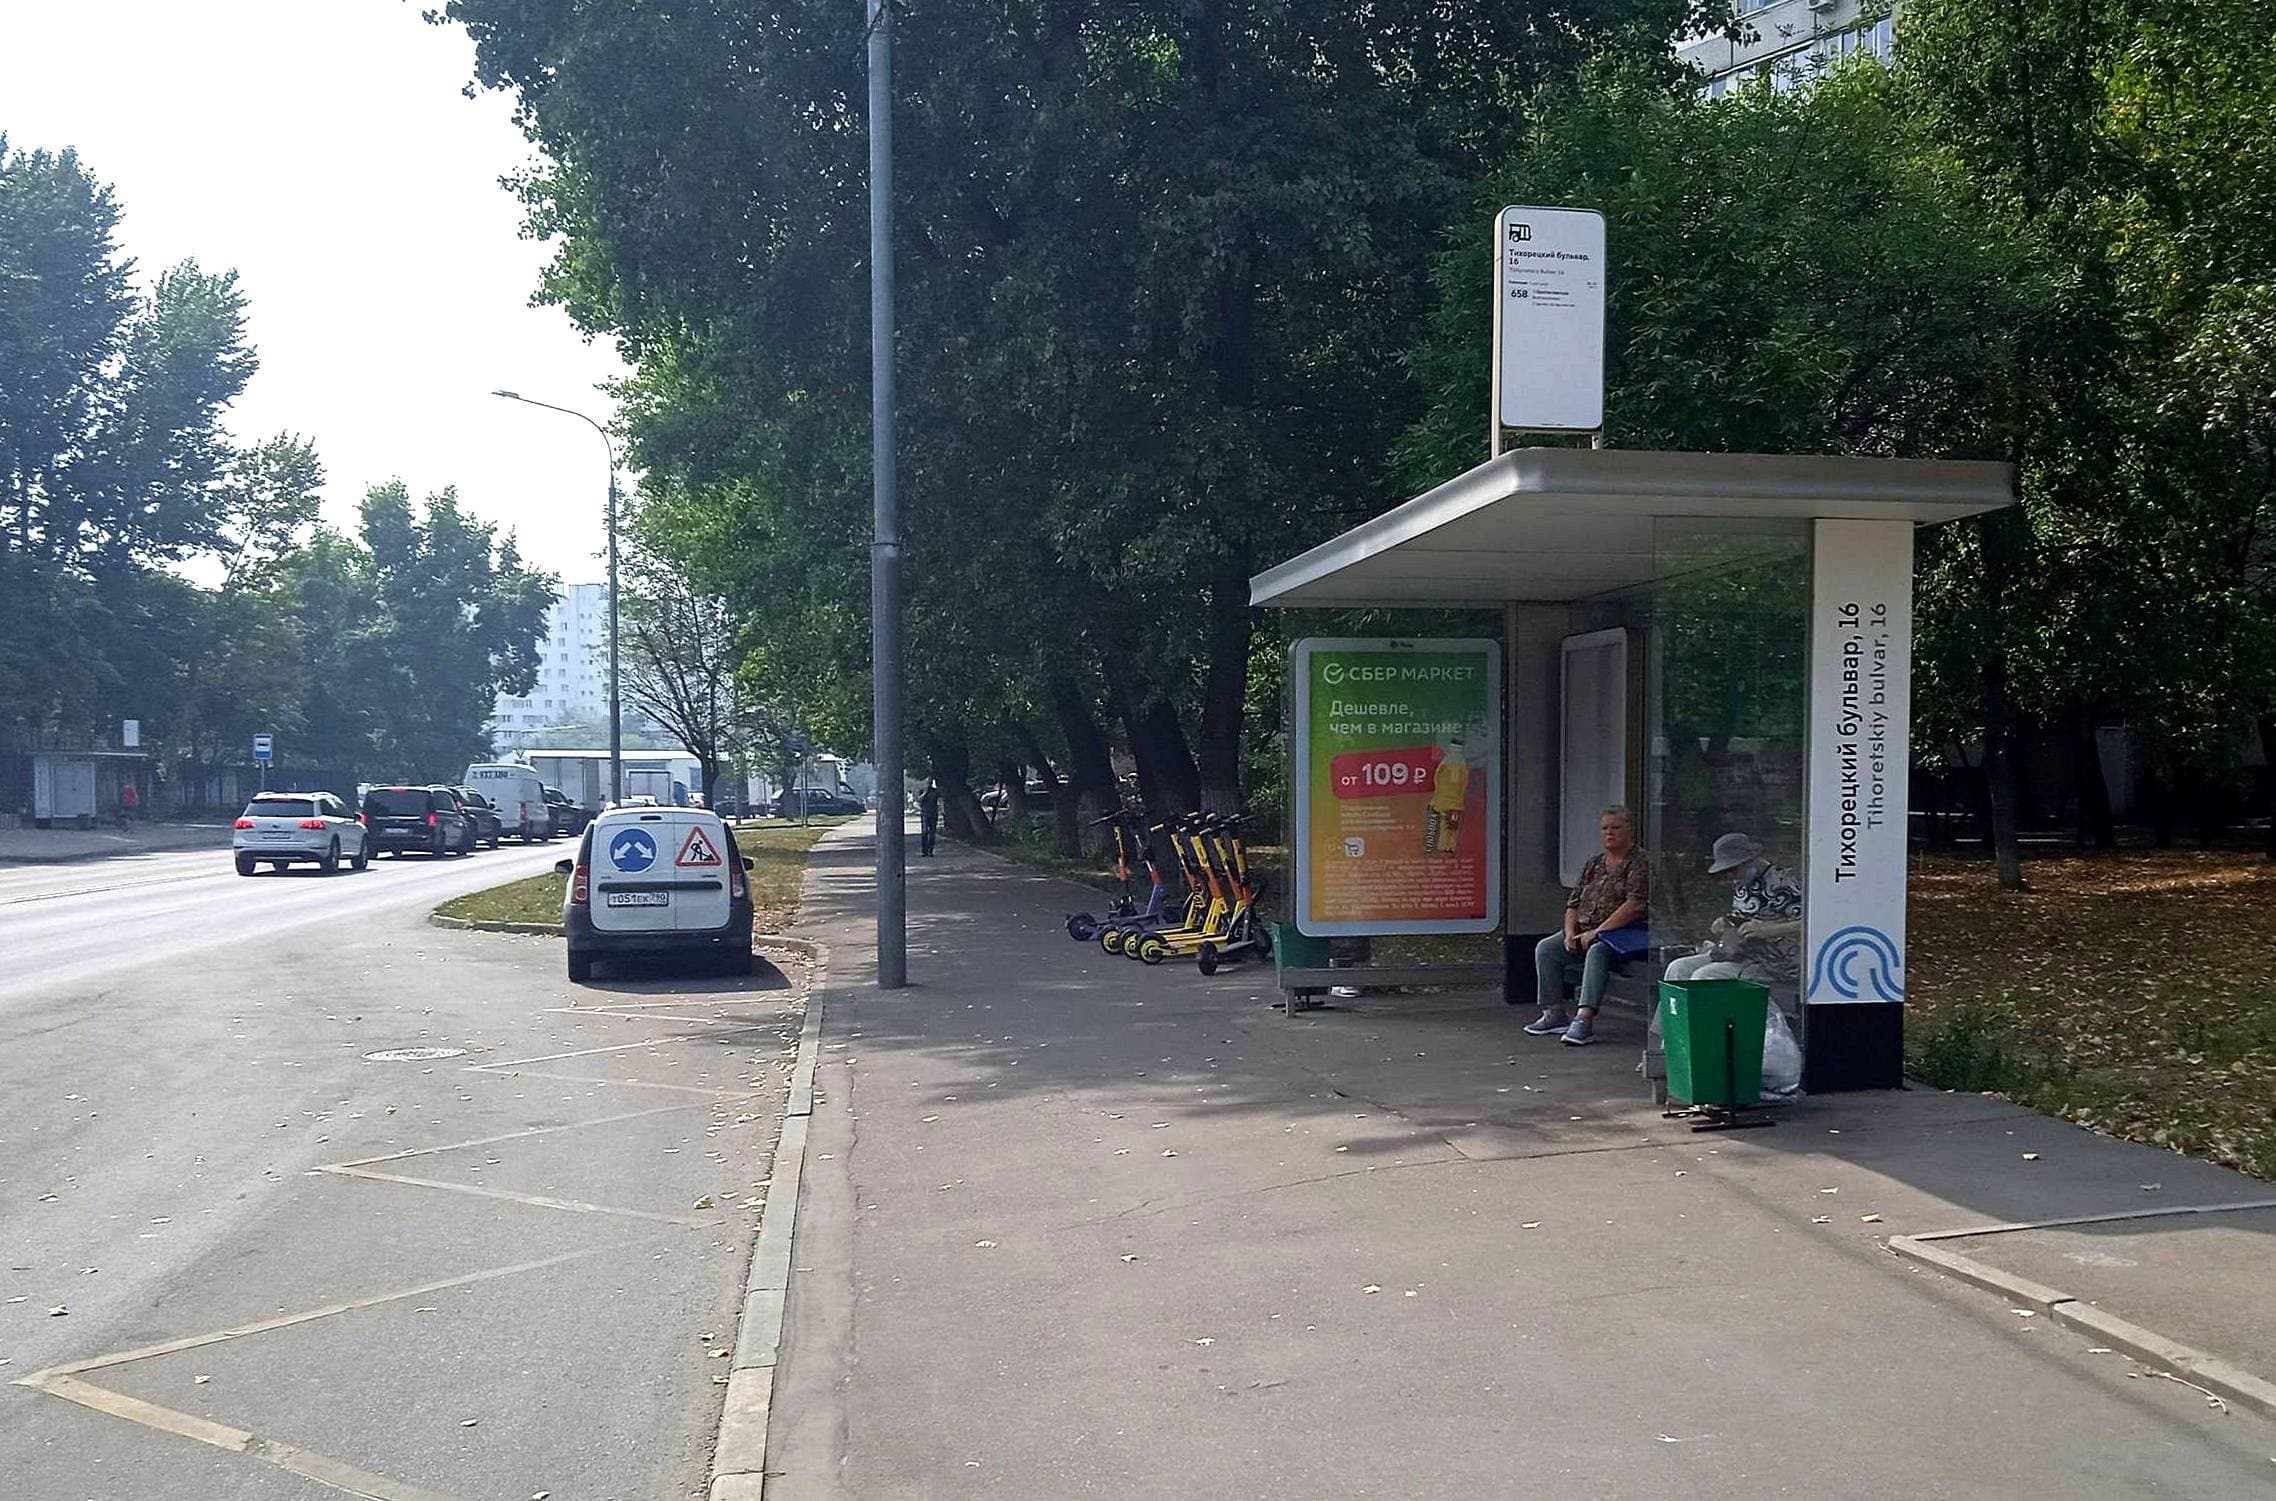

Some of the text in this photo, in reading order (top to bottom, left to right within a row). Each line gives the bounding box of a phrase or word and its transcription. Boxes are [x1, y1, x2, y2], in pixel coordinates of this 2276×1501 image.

[1509, 248, 1555, 259] Тихорецкий
[1511, 289, 1528, 298] 658
[1349, 666, 1475, 681] СБЕР МАРКЕТ
[1329, 700, 1415, 717] Дешевле,
[1868, 603, 1888, 830] Tihoretskiy bulvar, 16
[1329, 722, 1463, 735] чем в магазине
[1835, 603, 1864, 883] Тихорецкий бульвар, 16
[1341, 776, 1357, 786] от
[1362, 763, 1409, 786] 109
